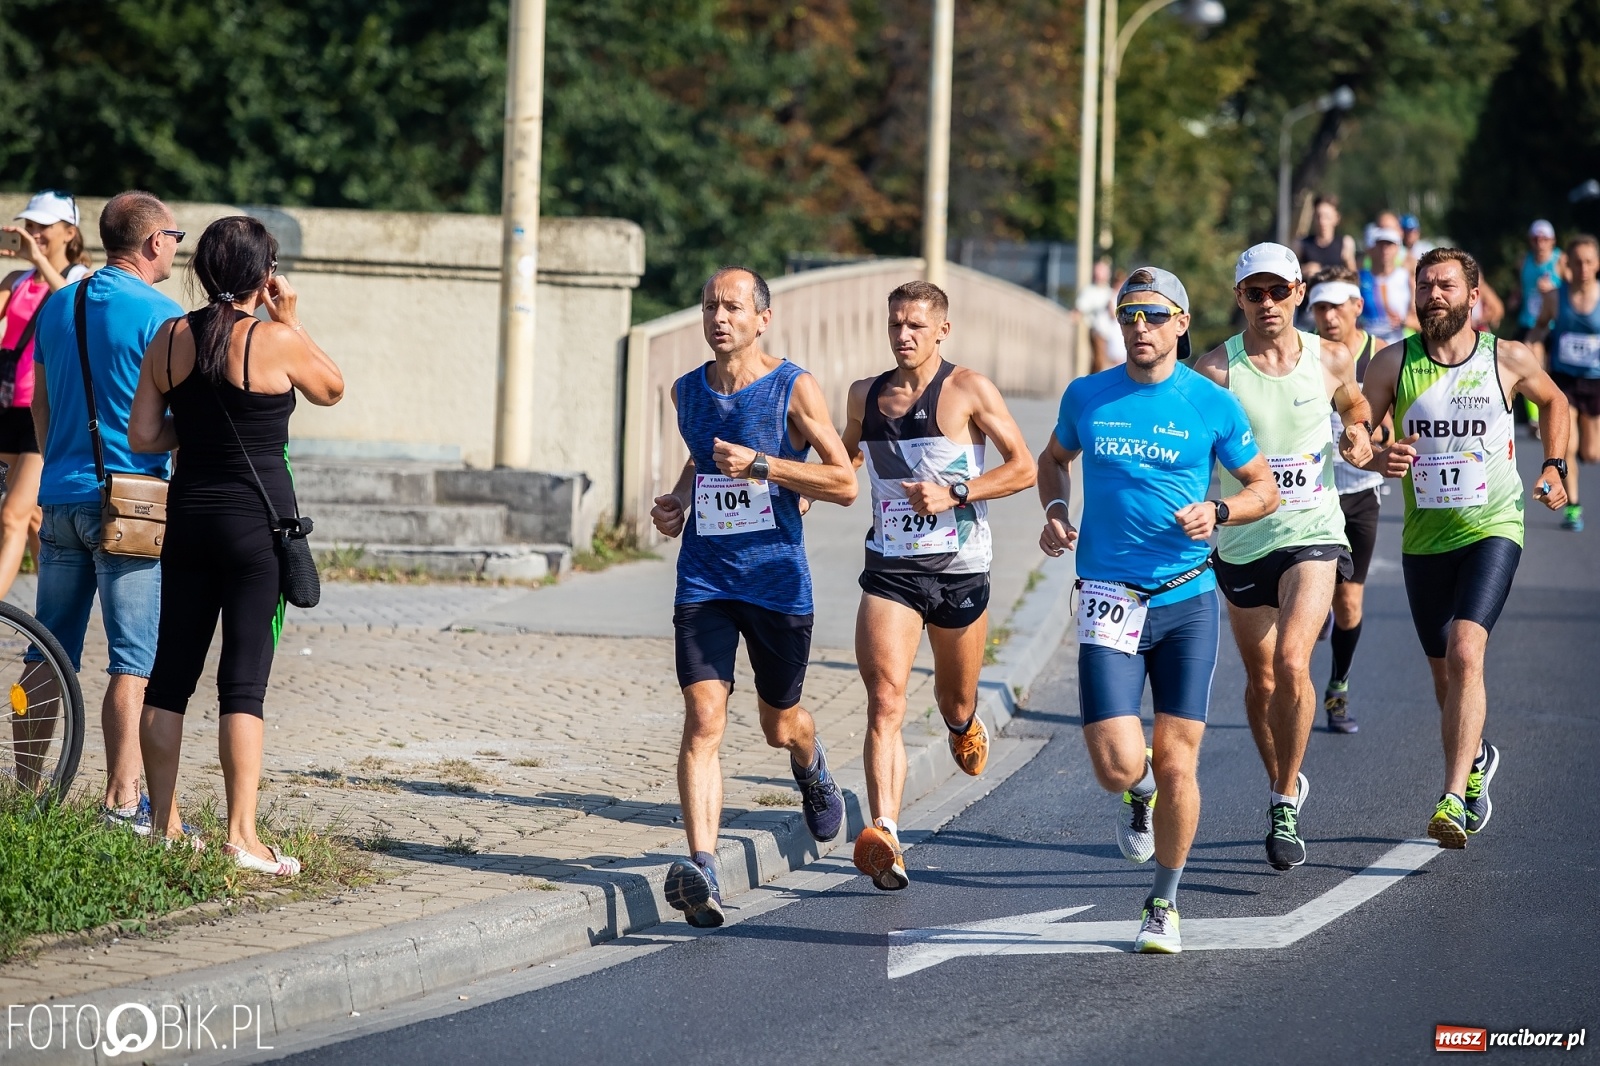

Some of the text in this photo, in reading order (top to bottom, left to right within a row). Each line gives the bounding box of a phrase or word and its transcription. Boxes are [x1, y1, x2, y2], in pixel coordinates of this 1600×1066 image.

[1450, 396, 1490, 405] AKTYWNI
[1409, 420, 1487, 438] IRBUD
[1095, 442, 1180, 464] KRAKÓW
[1272, 468, 1307, 489] 286
[1439, 467, 1461, 486] 17
[714, 489, 752, 511] 104
[901, 513, 938, 533] 299
[1165, 568, 1202, 589] CANYON
[1086, 598, 1125, 625] 390
